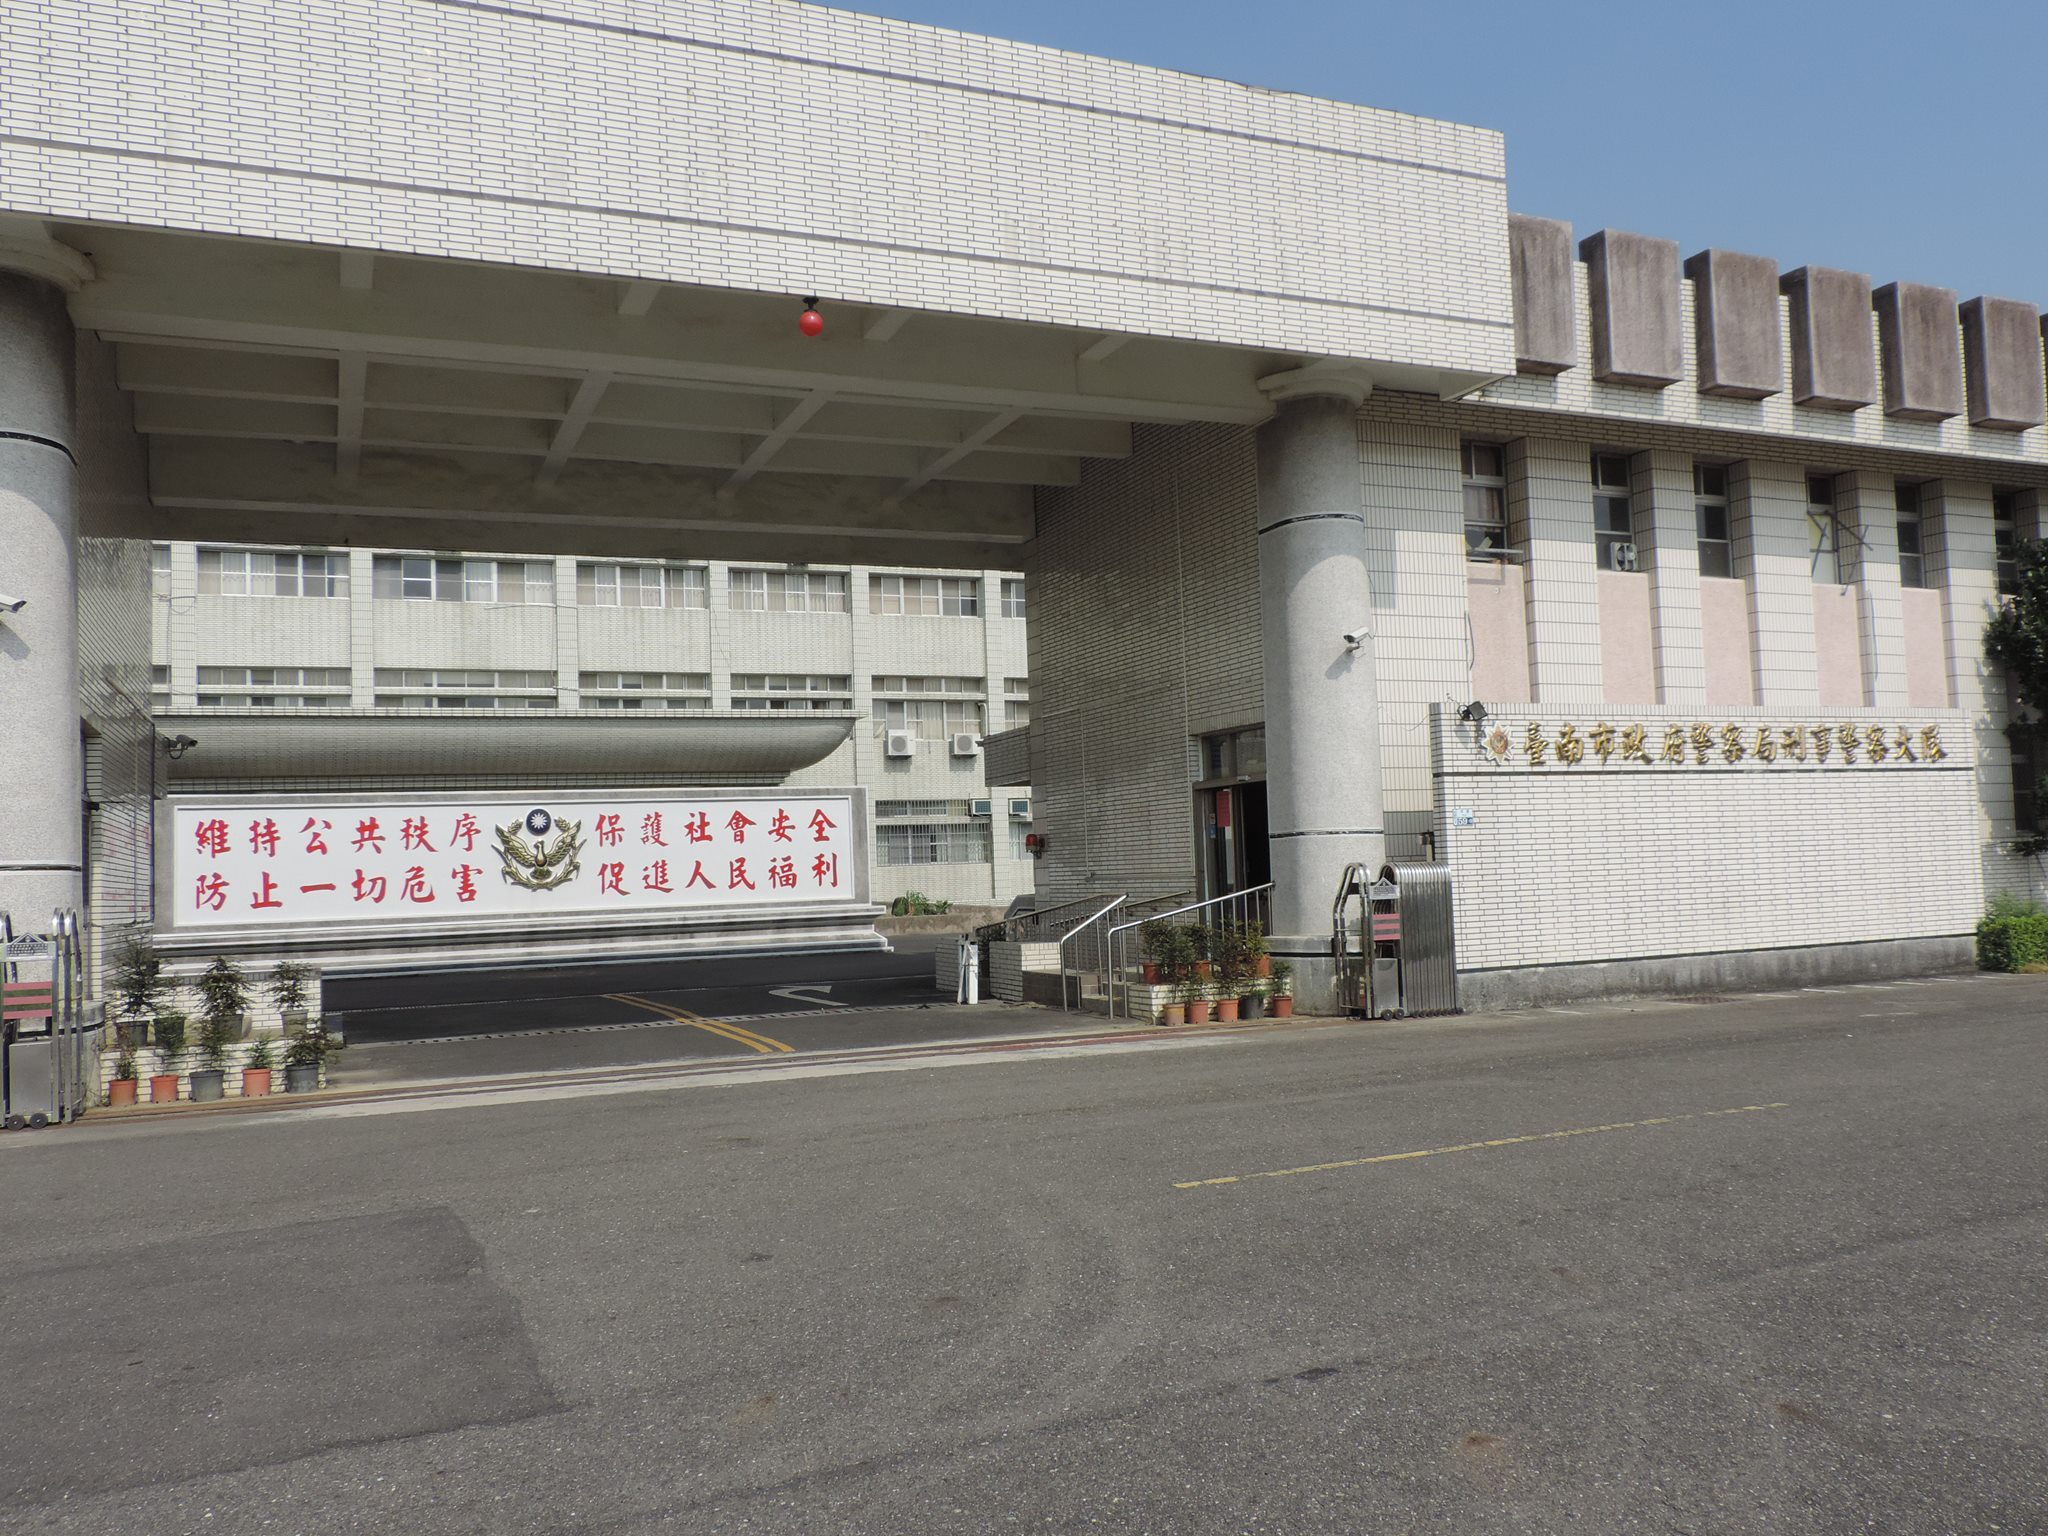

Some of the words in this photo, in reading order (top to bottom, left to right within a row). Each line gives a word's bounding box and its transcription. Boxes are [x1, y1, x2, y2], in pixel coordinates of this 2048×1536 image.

[1524, 721, 1947, 766] 臺南市政府警察局刑事警察大隊
[195, 813, 482, 858] 維持公共秩序
[595, 808, 838, 847] 保護社會安全
[195, 864, 484, 911] 防止一切危害
[597, 853, 838, 897] 促進人民福利
